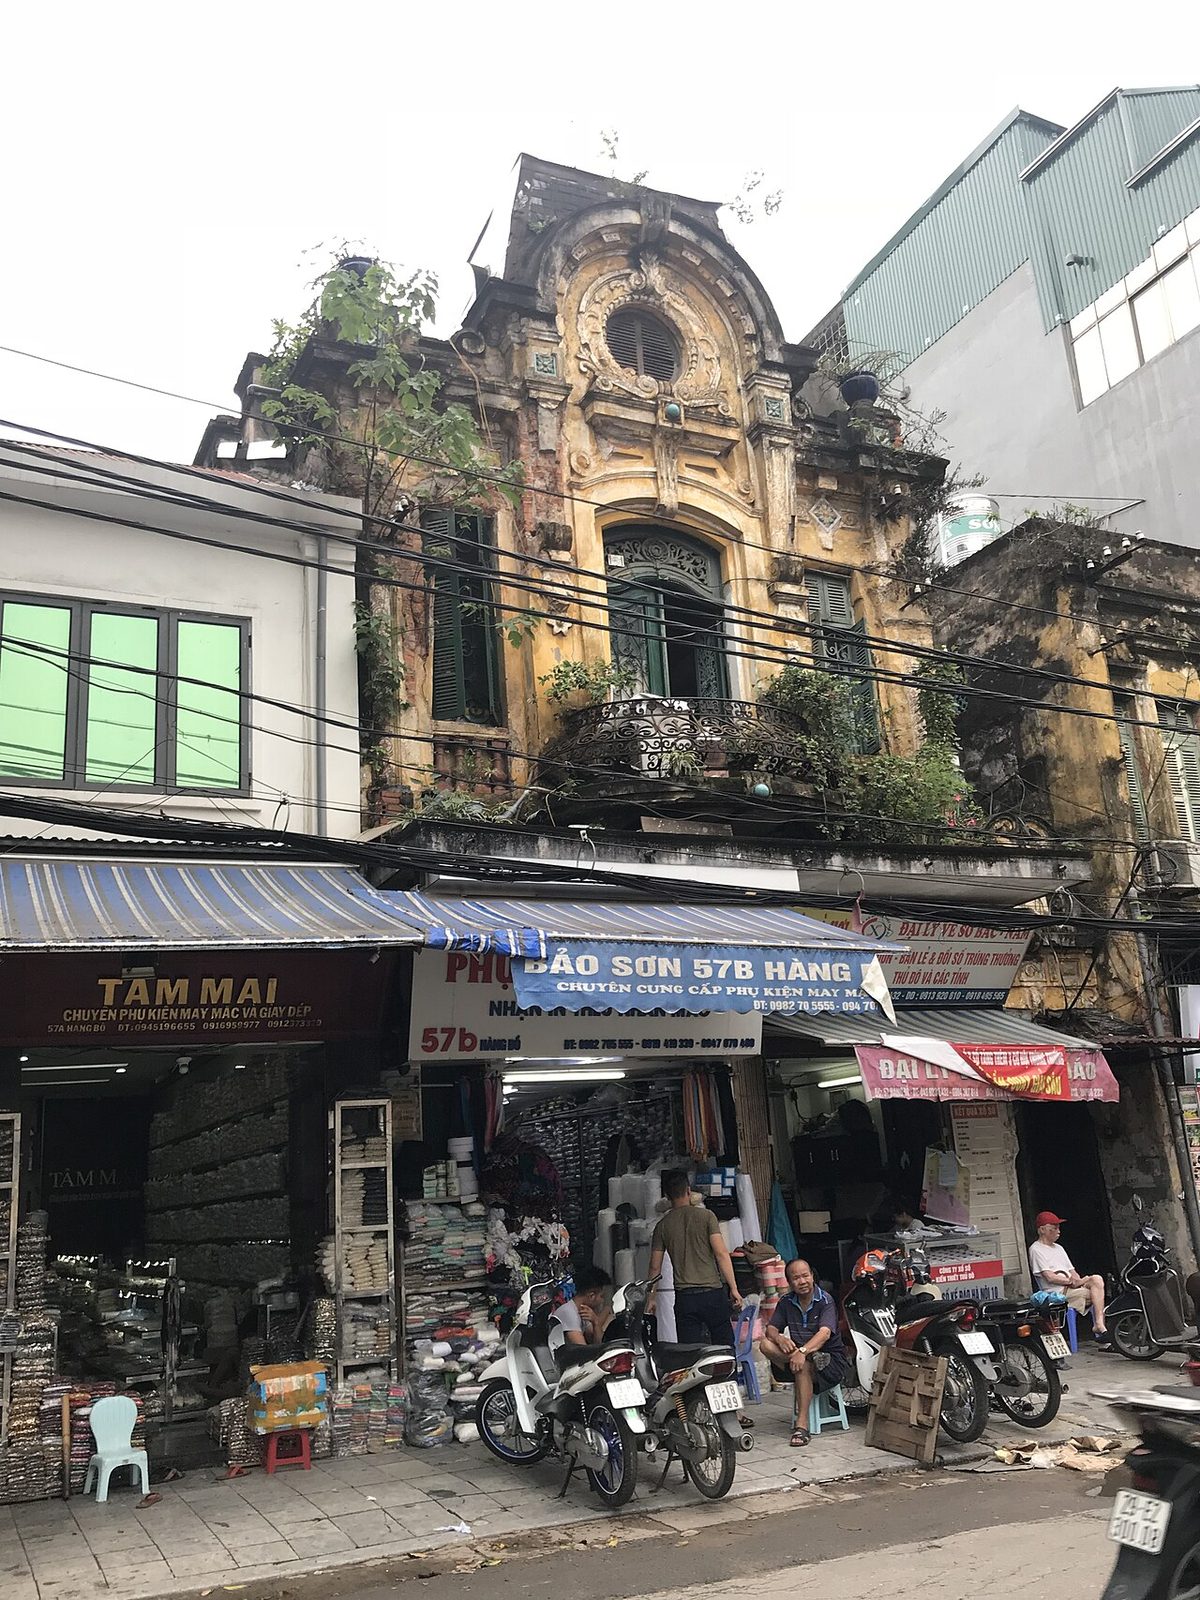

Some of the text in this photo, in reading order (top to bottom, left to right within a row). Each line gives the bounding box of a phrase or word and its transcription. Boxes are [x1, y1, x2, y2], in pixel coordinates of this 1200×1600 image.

[524, 948, 600, 977] BẢO
[611, 955, 682, 978] SƠN
[693, 959, 754, 980] 57B
[764, 958, 851, 982] HÀNG
[200, 977, 278, 1005] MAI
[556, 981, 631, 993] CHUYÊN
[636, 984, 684, 994] CUNG
[688, 983, 722, 995] CẤP
[725, 986, 759, 997] PHỤ
[763, 985, 803, 998] KIỆN
[808, 988, 840, 998] MAY
[63, 1005, 117, 1021] CHUYÊN
[179, 1008, 208, 1020] MAY
[769, 1002, 795, 1011] 0982
[811, 1002, 836, 1011] 5555
[842, 1003, 860, 1011] 094
[421, 1027, 478, 1053] 57b
[711, 1384, 736, 1399] 29-T8
[715, 1396, 739, 1411] 0489
